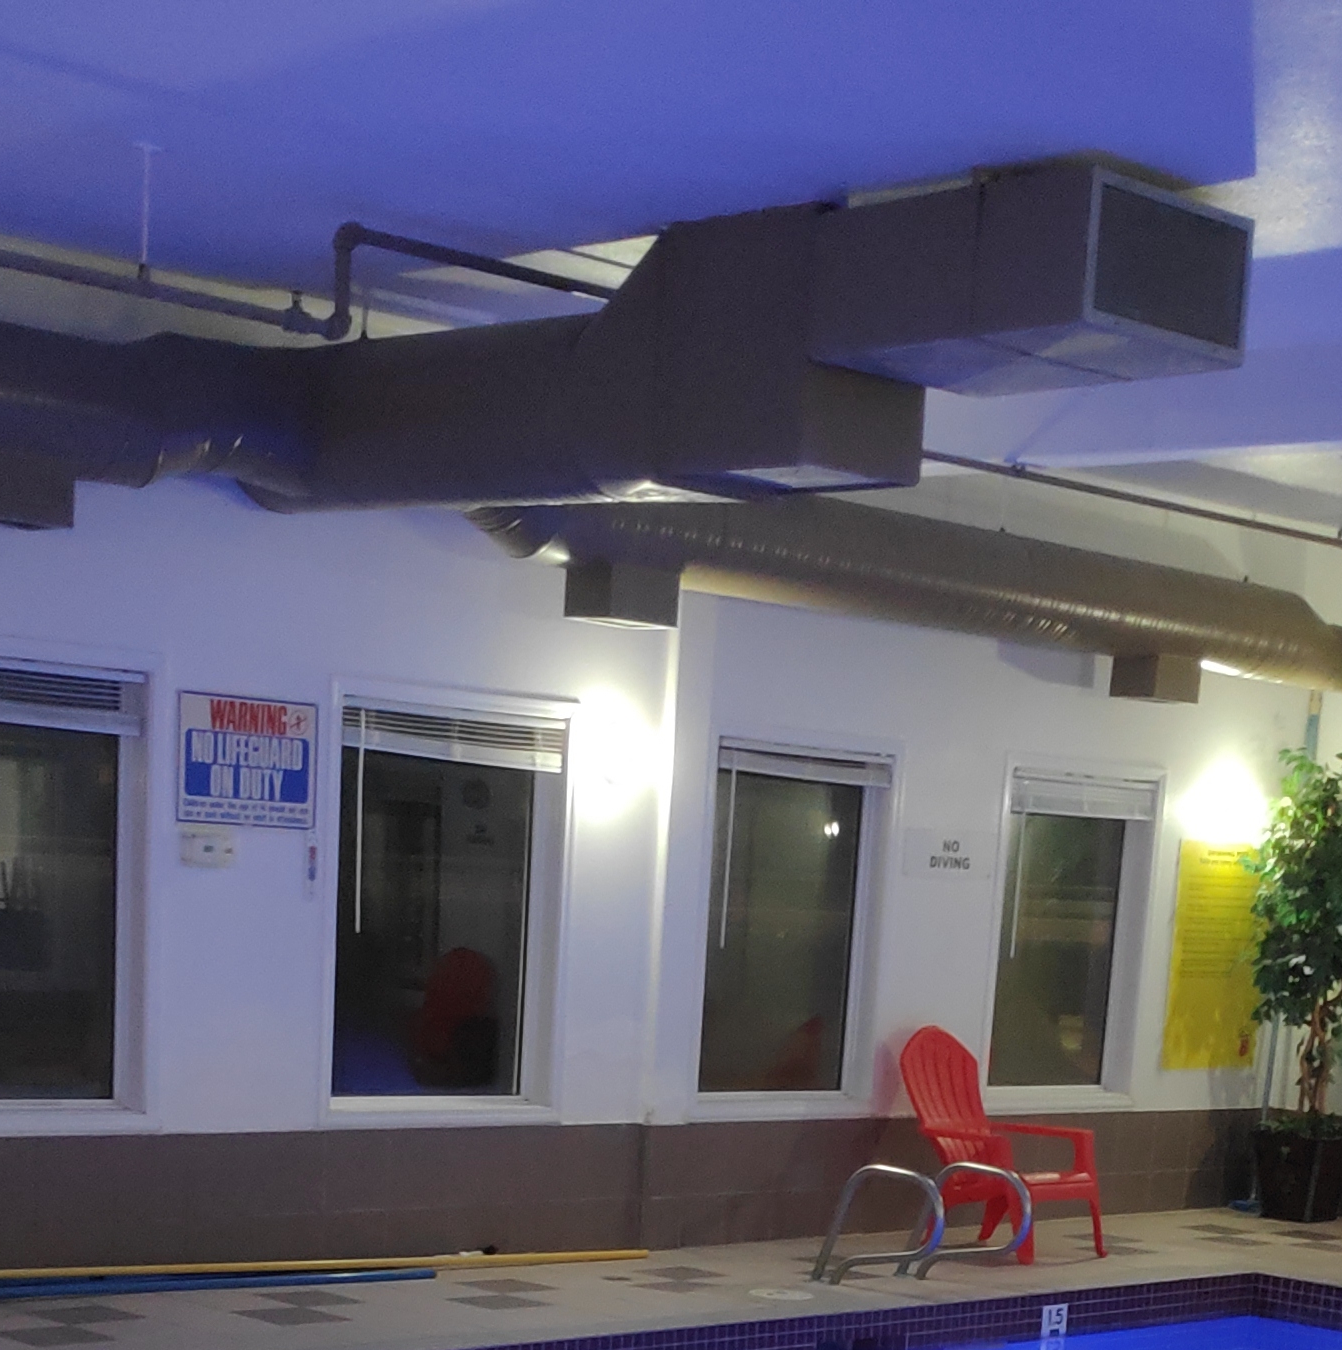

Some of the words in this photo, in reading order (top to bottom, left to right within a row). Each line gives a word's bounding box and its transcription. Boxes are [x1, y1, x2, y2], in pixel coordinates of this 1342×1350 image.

[210, 698, 288, 735] WARNING
[191, 730, 214, 764] NO
[217, 732, 303, 770] LIFEGUARD
[210, 765, 234, 798] ON
[240, 767, 283, 802] DUTY
[929, 855, 970, 870] DIVING
[942, 840, 960, 853] NO
